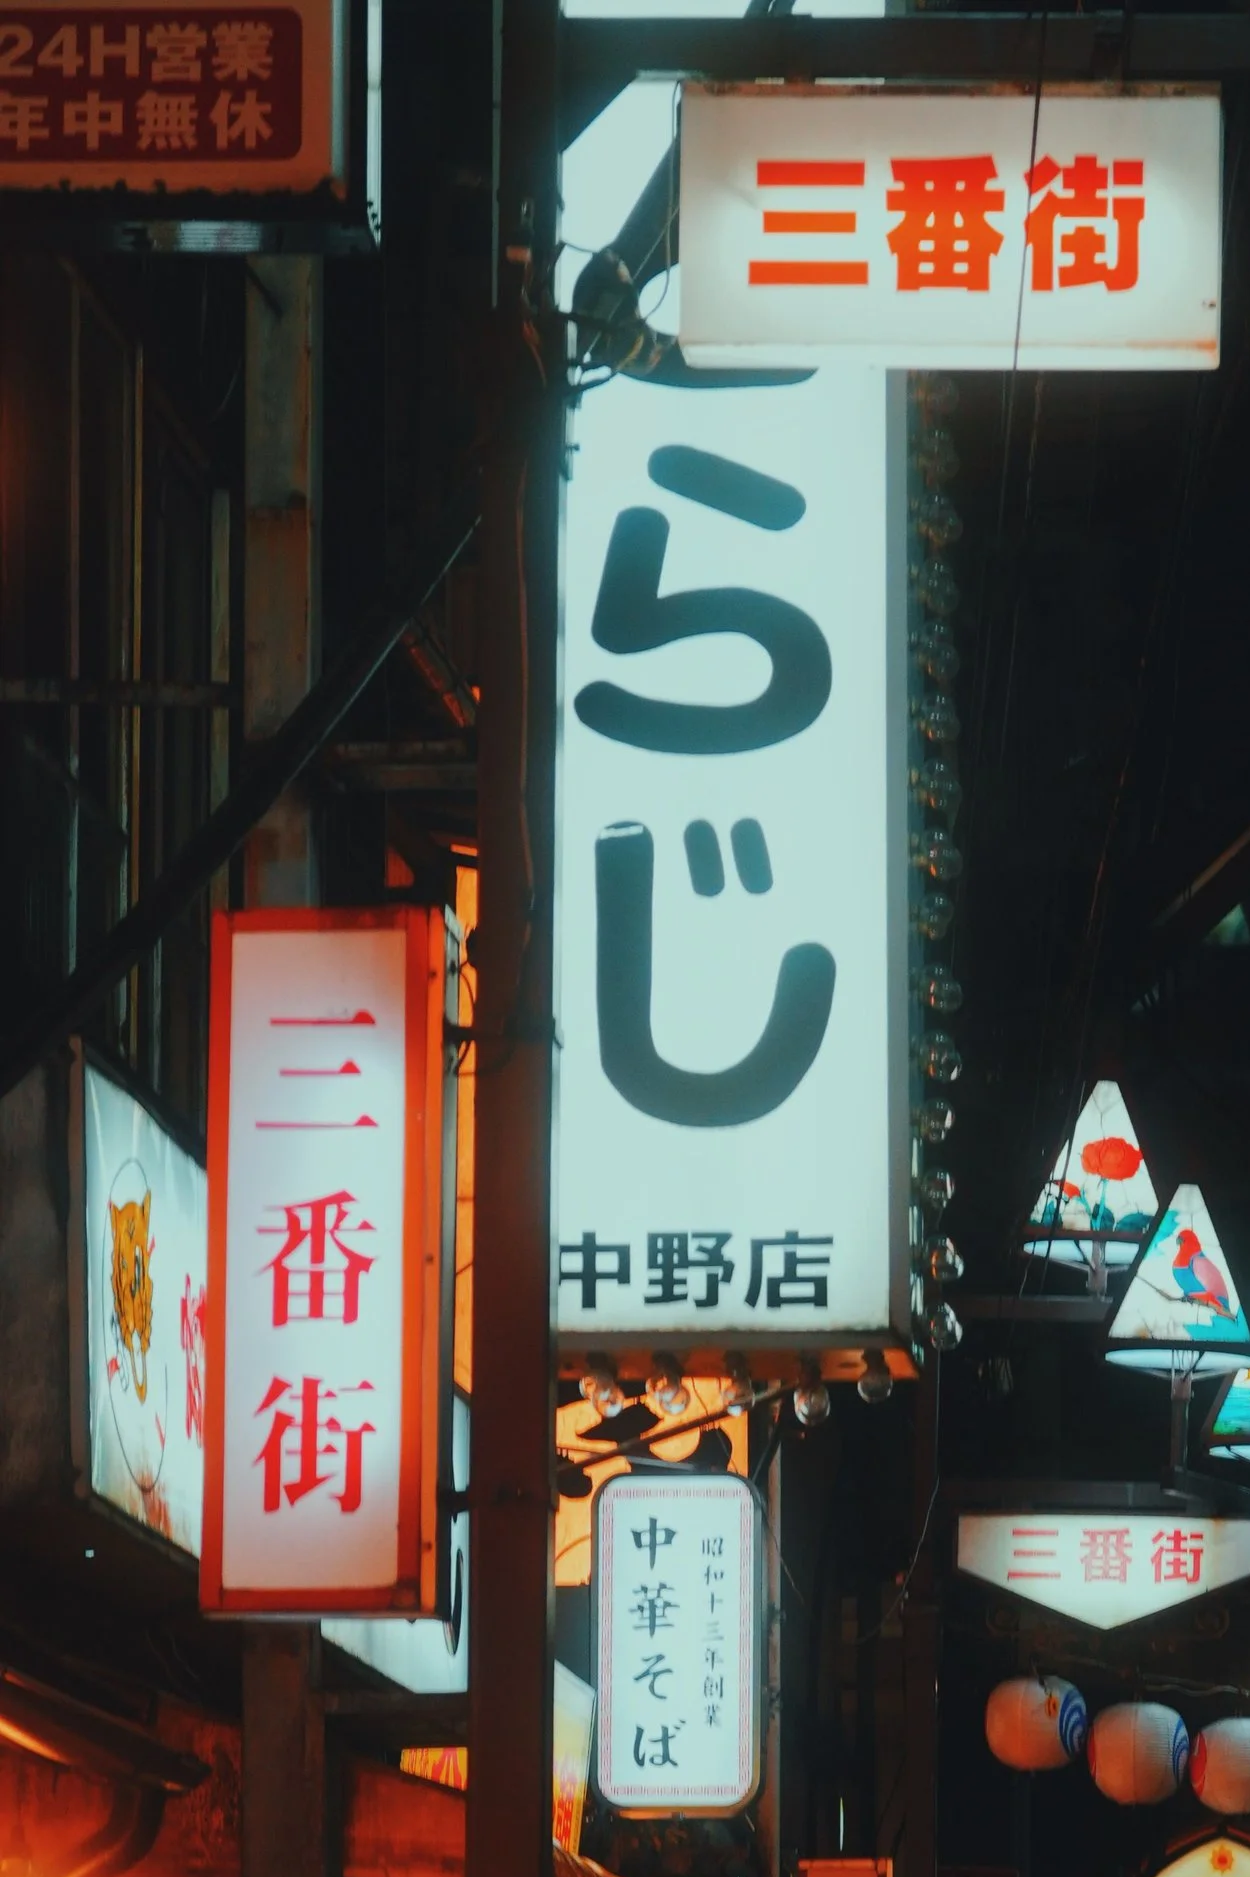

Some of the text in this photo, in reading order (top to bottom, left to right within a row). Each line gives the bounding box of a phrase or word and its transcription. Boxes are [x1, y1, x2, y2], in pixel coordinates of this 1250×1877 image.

[0, 20, 275, 83] 24H営業
[0, 88, 275, 152] 年中無休
[748, 153, 1145, 292] 三番街
[254, 1008, 380, 1516] 三番街
[559, 1230, 834, 1310] 中野店
[1006, 1528, 1205, 1584] 三番街
[628, 1517, 687, 1768] 中華そば
